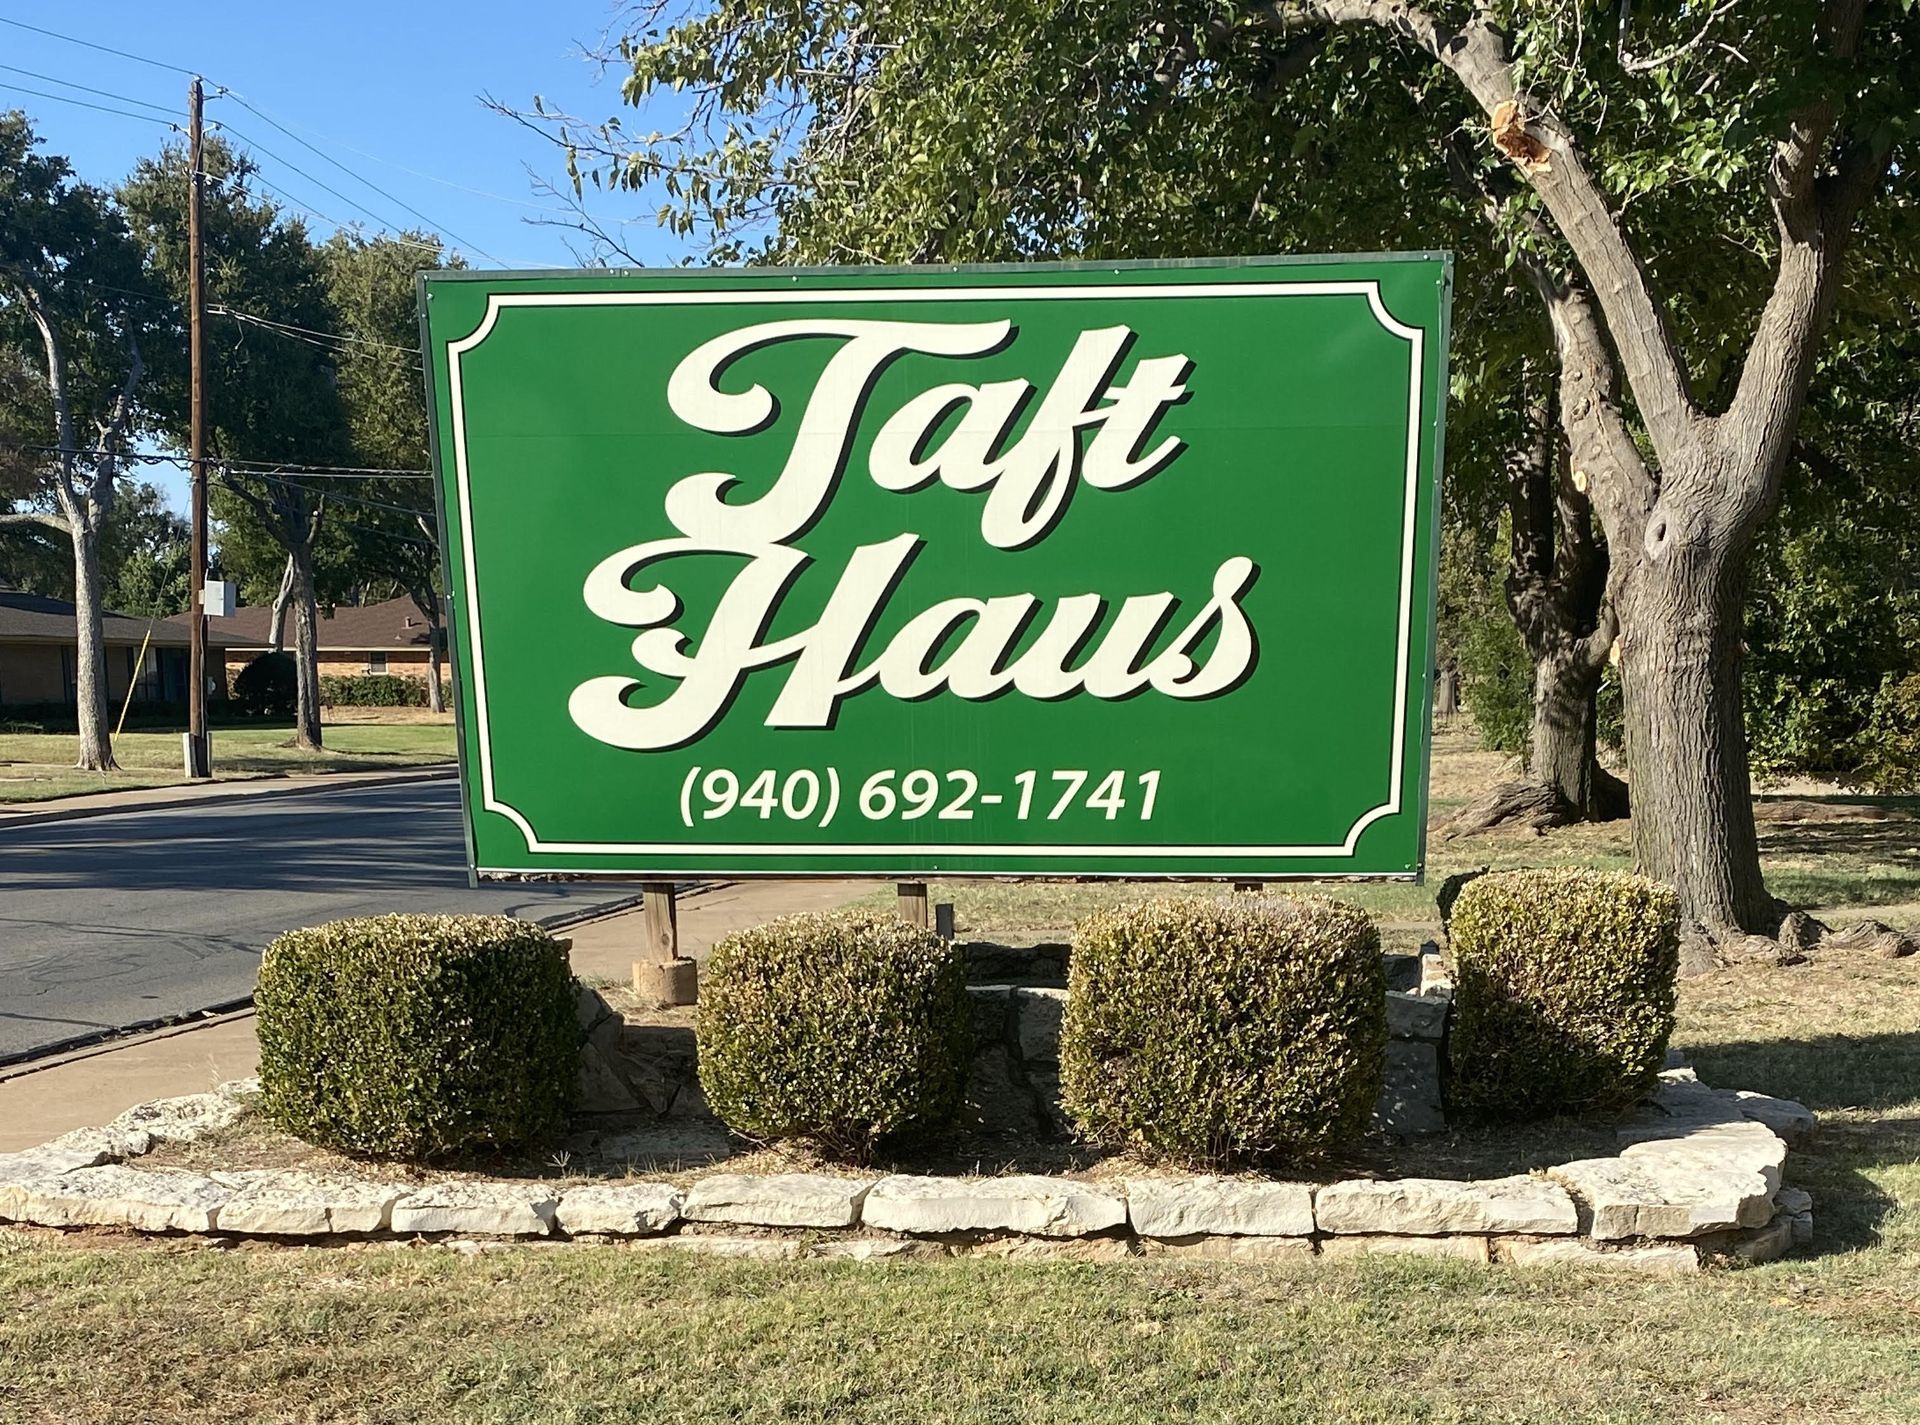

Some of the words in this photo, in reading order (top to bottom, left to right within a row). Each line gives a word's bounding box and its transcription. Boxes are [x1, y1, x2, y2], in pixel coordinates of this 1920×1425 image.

[665, 319, 1192, 549] Taft
[568, 532, 1256, 751] Haus
[680, 766, 840, 828] (940)
[859, 768, 1161, 821] 692-1741
